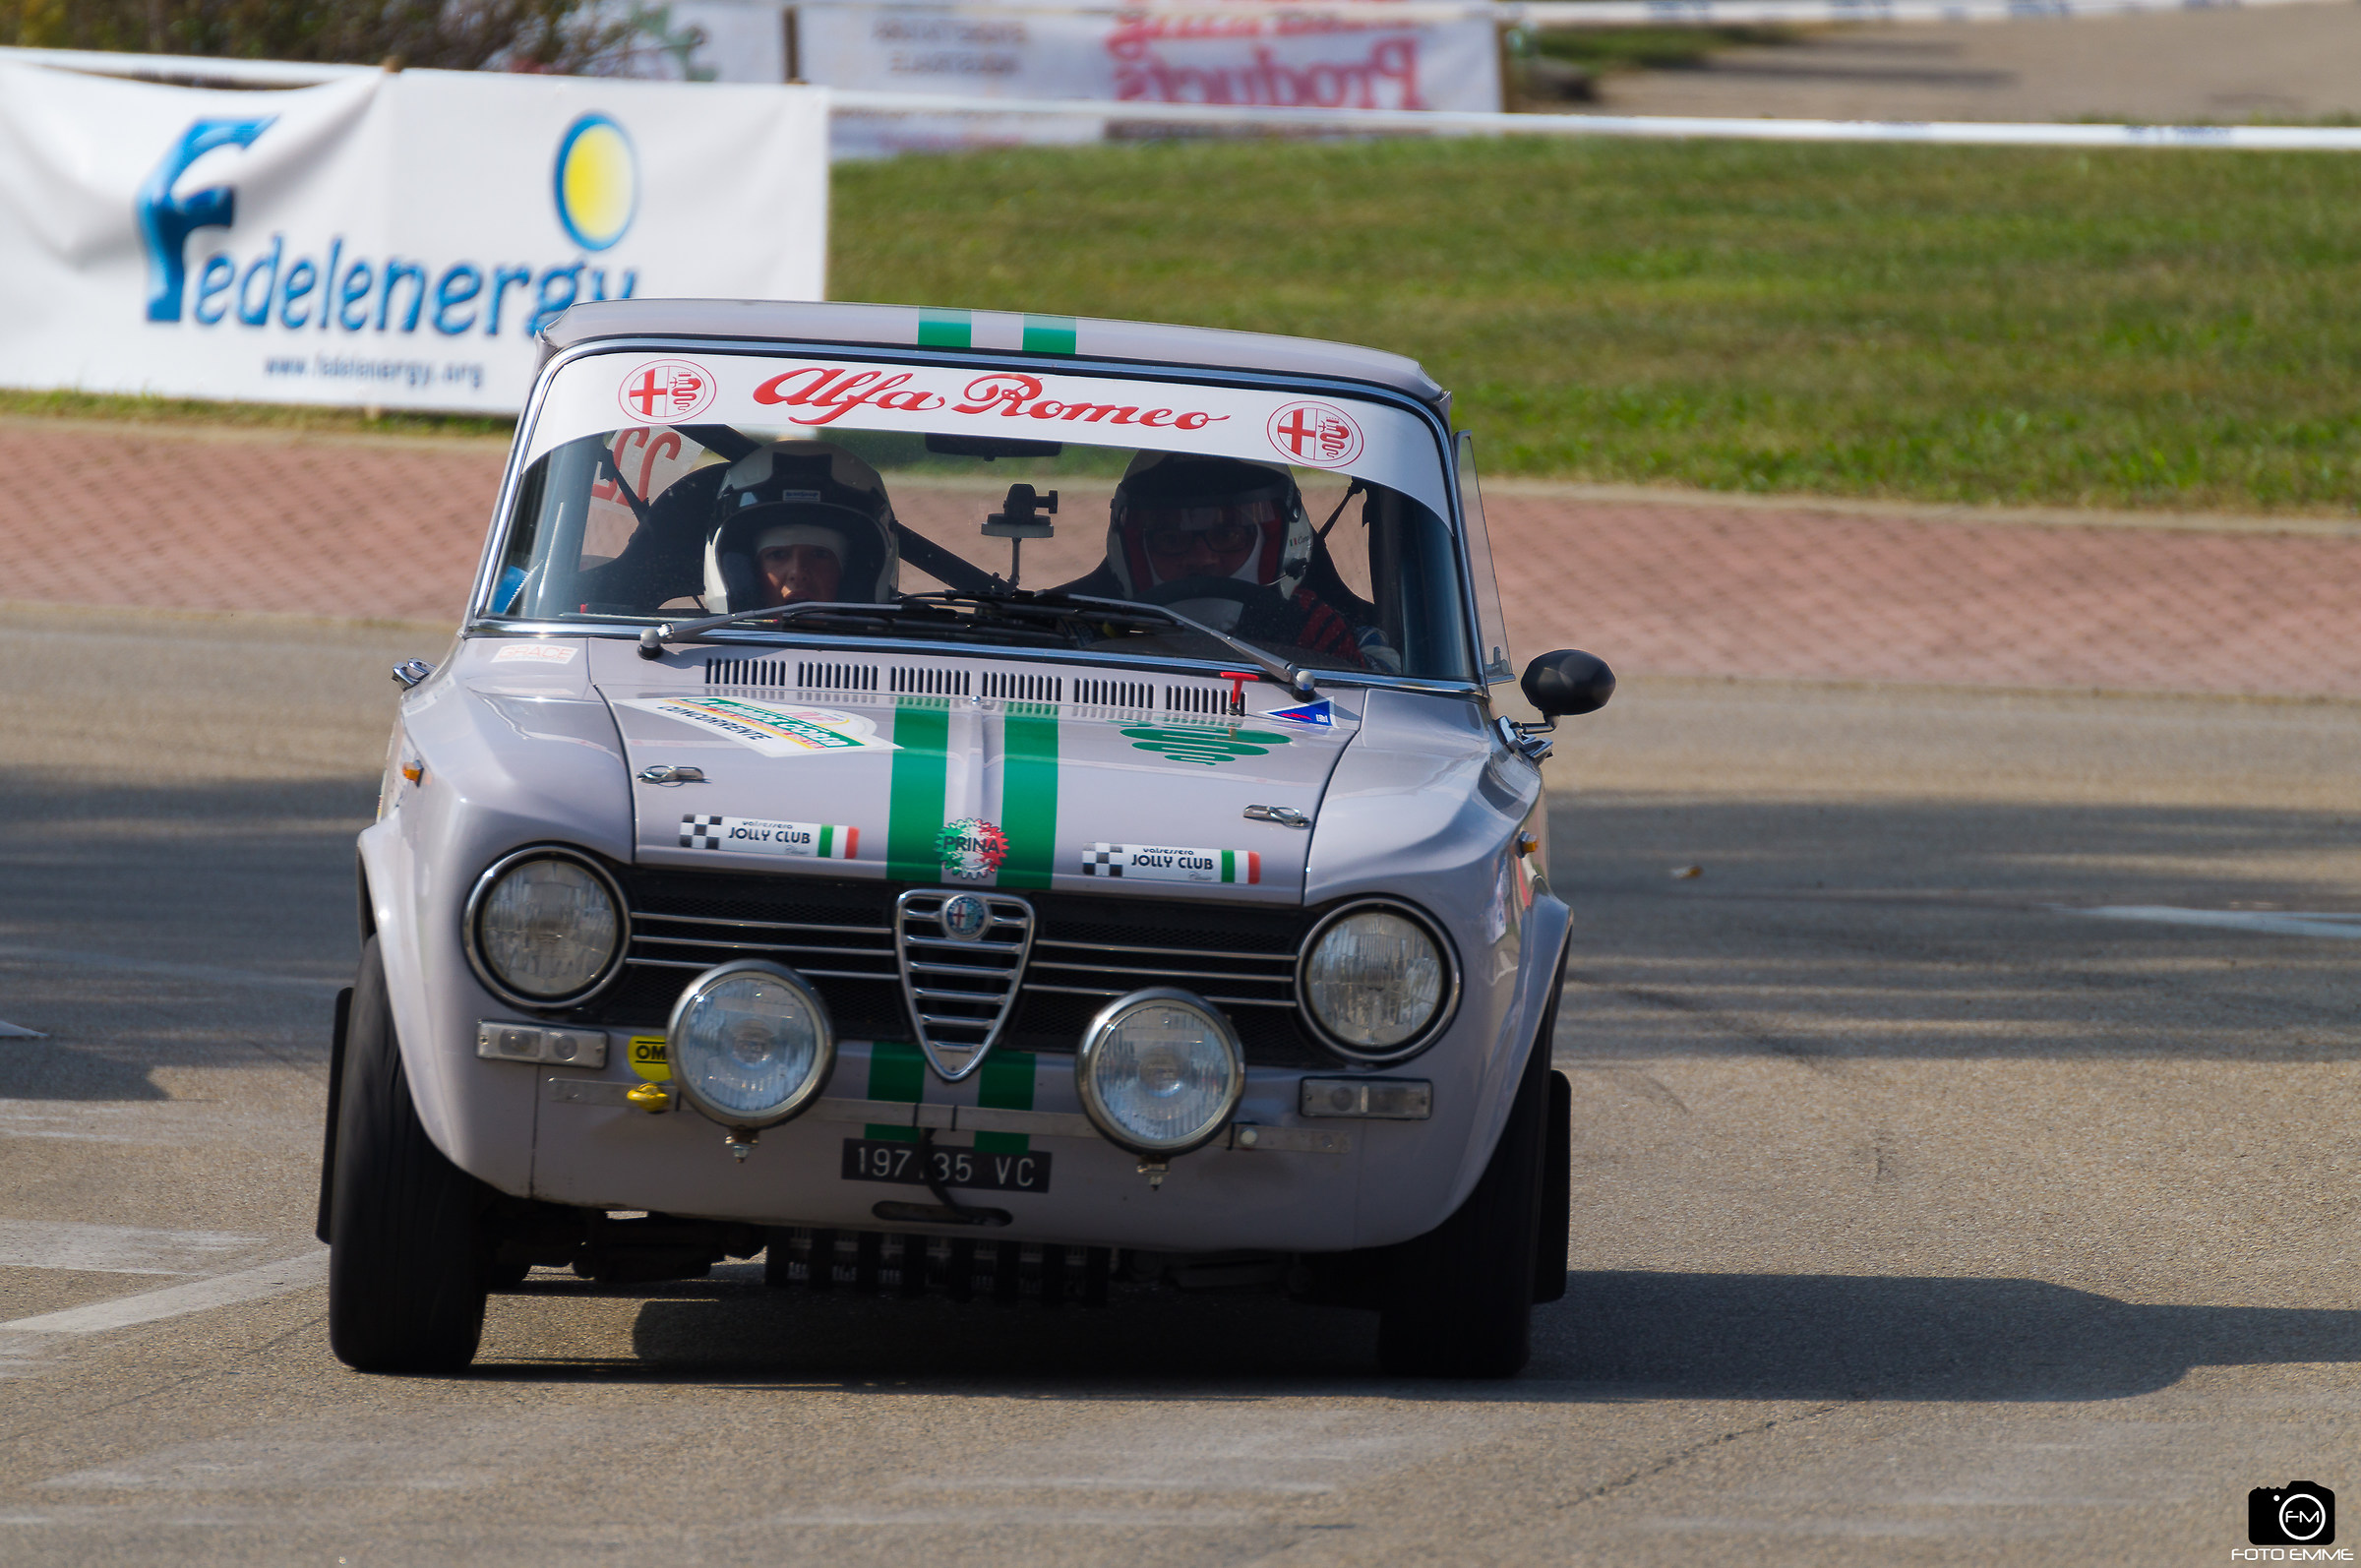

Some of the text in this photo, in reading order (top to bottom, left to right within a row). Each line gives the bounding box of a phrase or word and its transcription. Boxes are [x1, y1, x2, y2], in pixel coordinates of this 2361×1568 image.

[753, 367, 1231, 430] Alfa Romeo
[728, 826, 811, 844] JOLLY CLUB
[942, 835, 1000, 854] PRINA
[1131, 854, 1214, 871] JOLLY CLUB
[636, 1044, 666, 1060] OM
[858, 1147, 1035, 1187] 19735 VC
